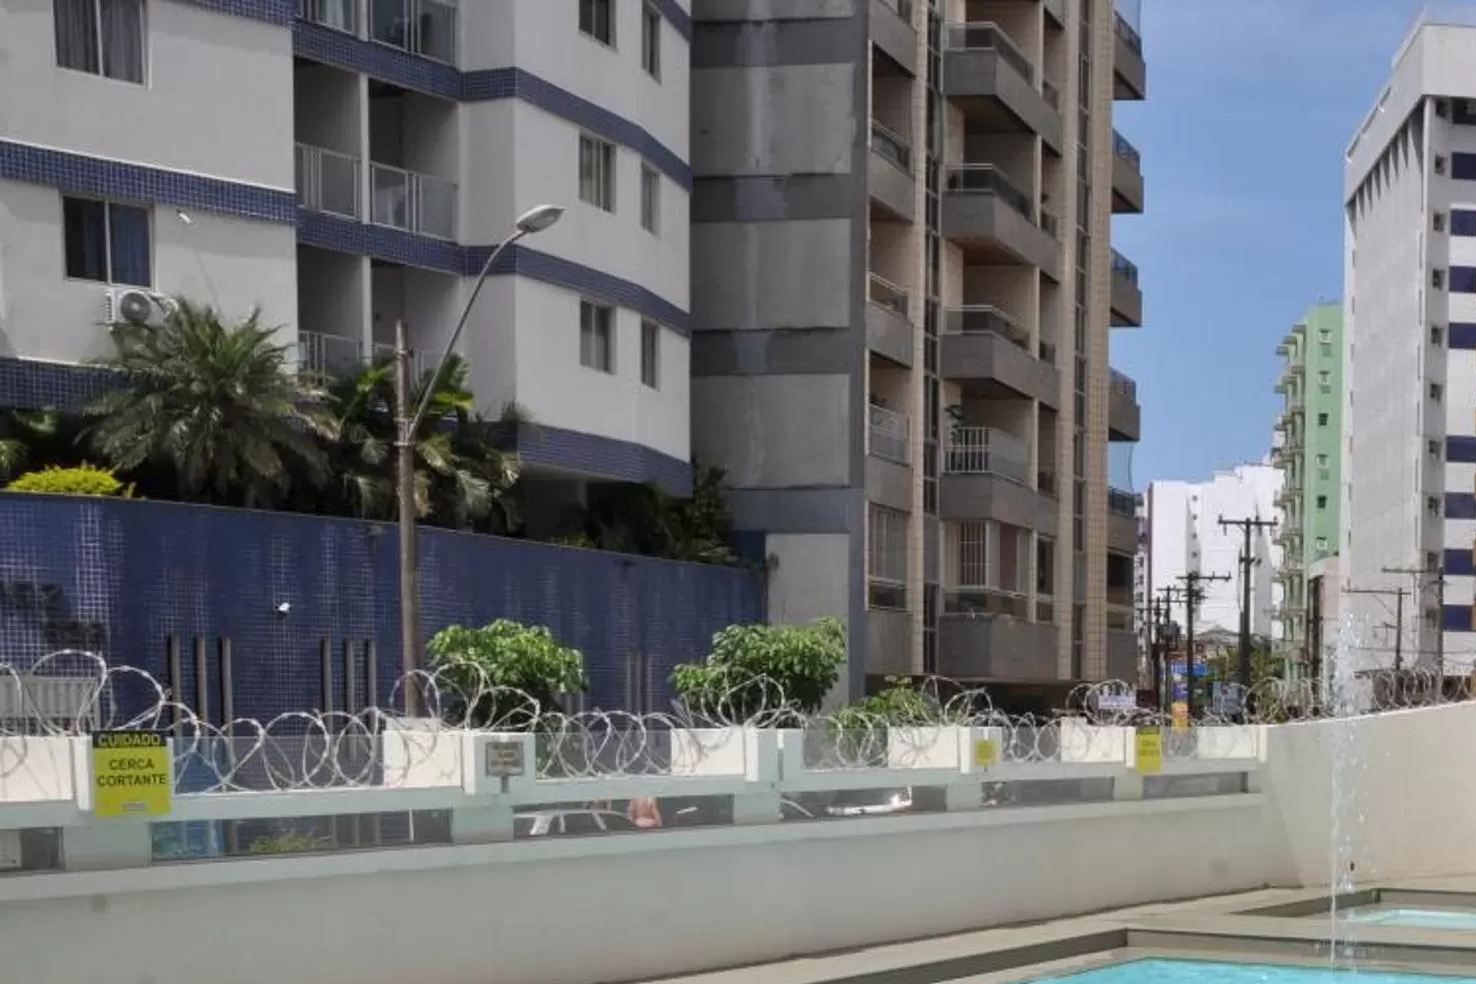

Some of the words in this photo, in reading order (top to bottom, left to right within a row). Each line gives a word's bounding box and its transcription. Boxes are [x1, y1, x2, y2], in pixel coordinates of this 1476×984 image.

[98, 733, 161, 747] CUIDADO
[109, 758, 155, 770] CERCA
[97, 773, 167, 787] CORTANTE
